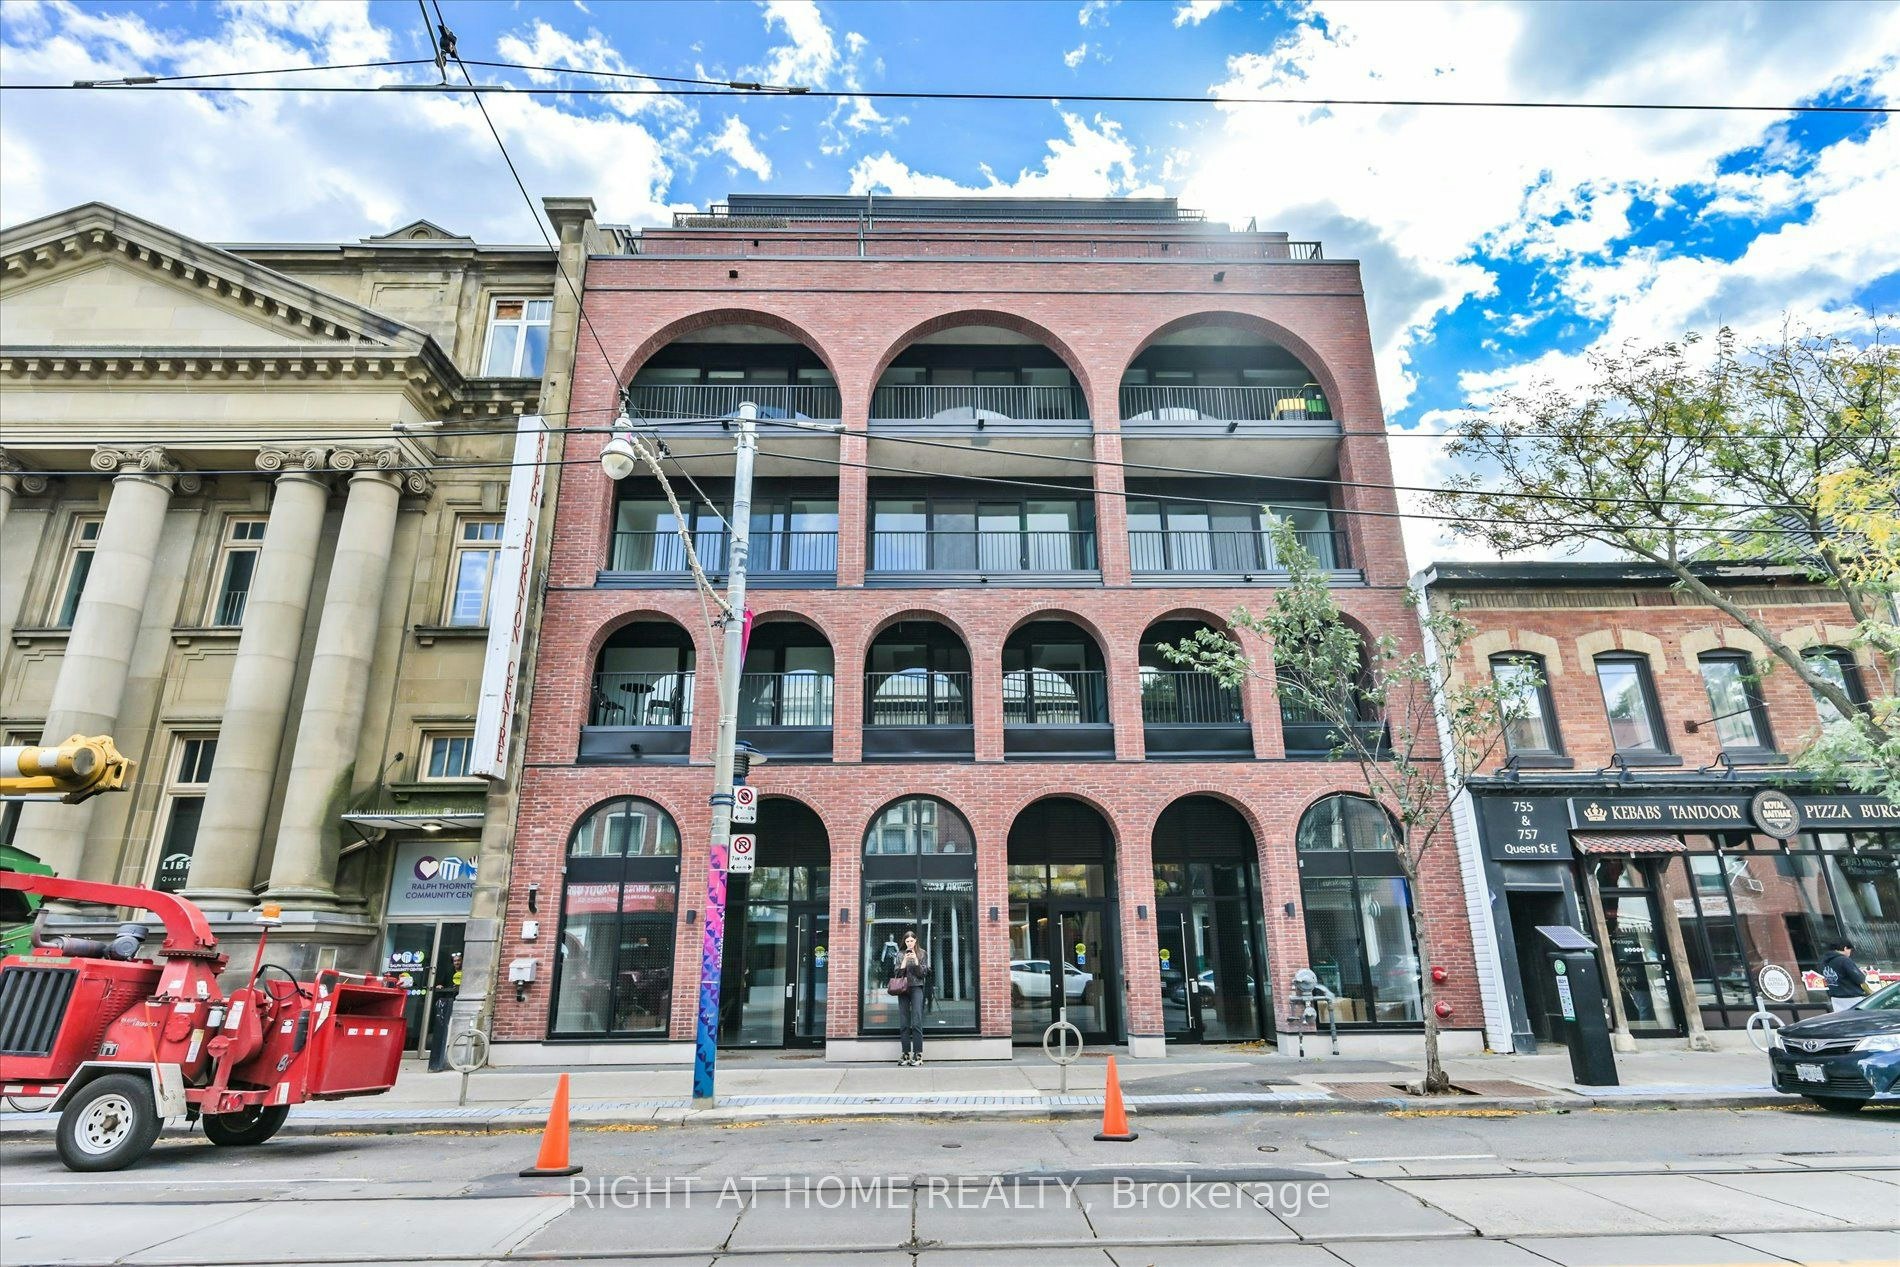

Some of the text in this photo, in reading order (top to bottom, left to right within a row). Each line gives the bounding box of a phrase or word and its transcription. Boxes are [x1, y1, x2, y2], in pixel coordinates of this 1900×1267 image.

[496, 431, 545, 763] RALPH THORNTON CENTRE
[1512, 801, 1534, 812] 755
[1762, 800, 1787, 810] ROYAL
[1611, 804, 1900, 820] KEBABS TANDOOR PIZZA BURG
[1521, 815, 1531, 826] &
[1517, 829, 1538, 840] 757
[1504, 843, 1558, 854] Queen St E
[411, 882, 437, 890] RALPH
[405, 891, 473, 899] COMMUNITY CEN
